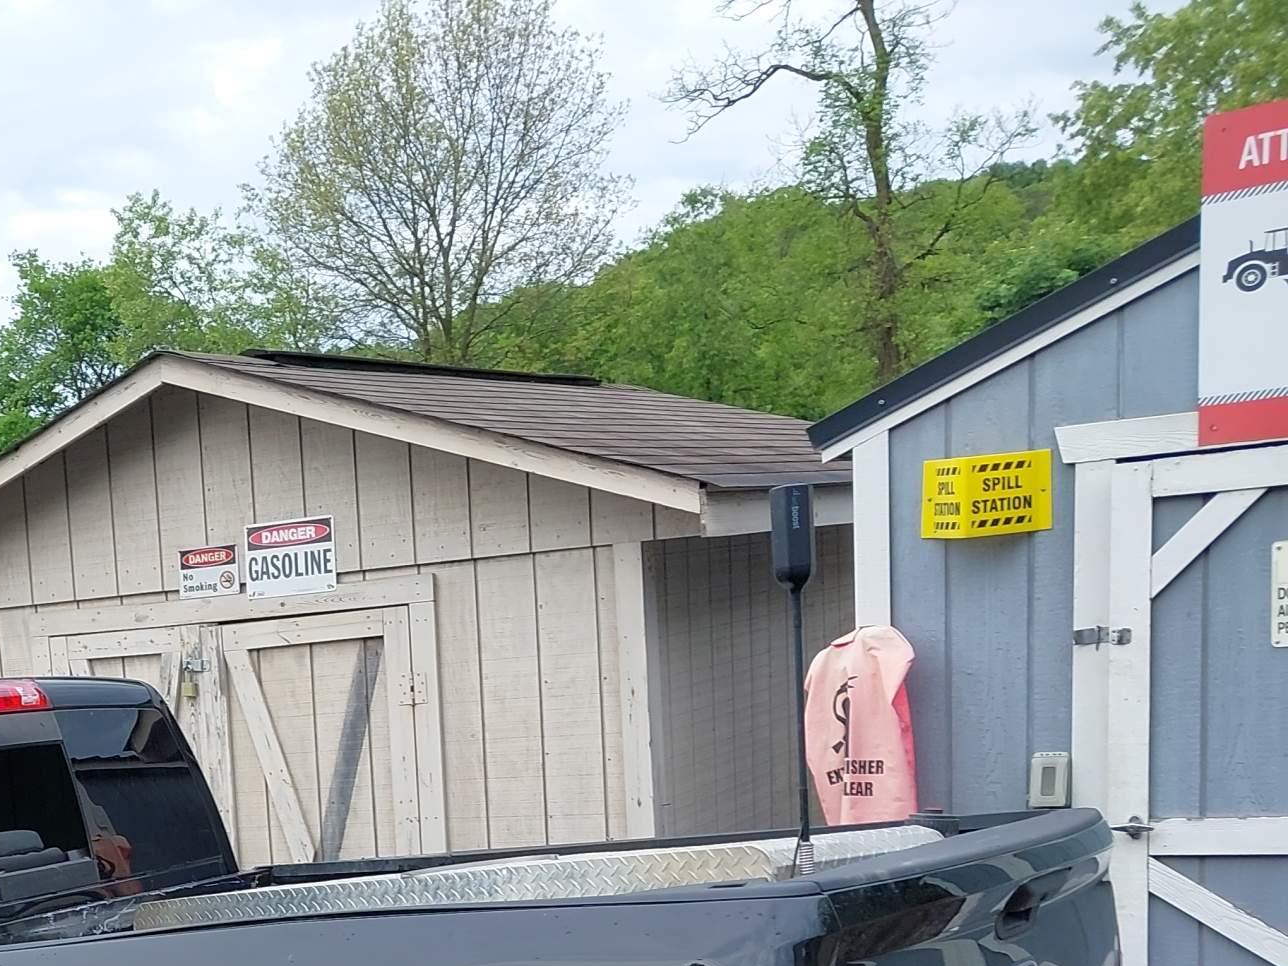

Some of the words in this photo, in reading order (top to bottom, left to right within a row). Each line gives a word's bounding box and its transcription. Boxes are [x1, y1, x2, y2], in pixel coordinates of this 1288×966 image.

[982, 475, 1022, 492] SPILL
[971, 494, 1033, 515] STATION
[261, 525, 316, 545] DANGER
[188, 551, 227, 565] DANGER
[248, 548, 333, 582] GASOLINE
[183, 573, 194, 582] No
[183, 582, 218, 593] Smoking
[846, 759, 884, 775] ISHER
[844, 781, 873, 797] LEAR
